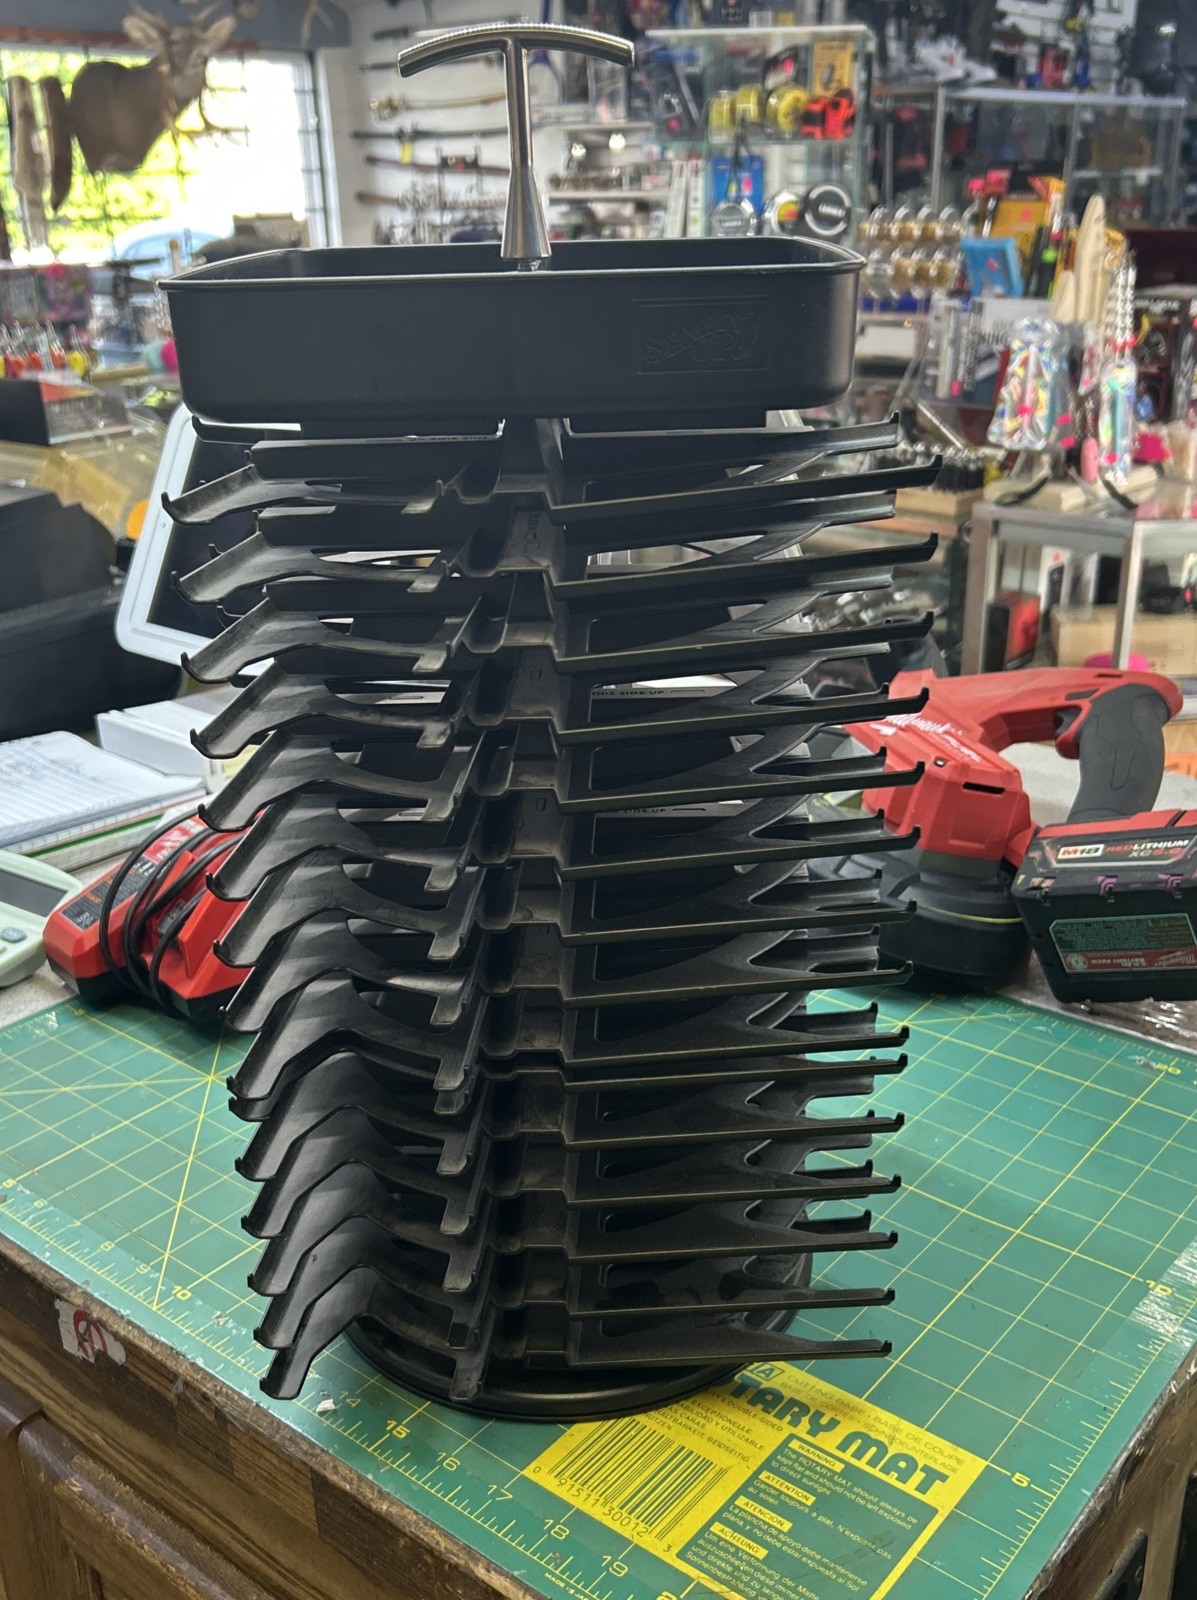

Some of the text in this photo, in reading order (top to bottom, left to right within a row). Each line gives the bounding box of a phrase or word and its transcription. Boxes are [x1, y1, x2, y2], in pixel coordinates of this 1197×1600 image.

[1061, 846, 1100, 857] M18
[172, 1286, 192, 1300] 10
[386, 1420, 410, 1438] 15
[728, 1373, 950, 1495] TARY MAT
[799, 1444, 836, 1468] WARNING
[906, 1433, 923, 1445] DE
[924, 1442, 965, 1466] COUPE
[436, 1452, 460, 1471] 16
[753, 1479, 779, 1496] Garder
[764, 1474, 810, 1501] ATTENTION
[833, 1475, 852, 1488] MAT
[1011, 1472, 1031, 1488] 5
[486, 1484, 513, 1501] 17
[533, 1466, 673, 1553] 0 91511 30012 3
[742, 1501, 786, 1527] ATENCION
[544, 1520, 569, 1540] 18
[718, 1528, 760, 1554] ACHTUNG
[602, 1556, 628, 1577] 19
[544, 1572, 566, 1588] MADE
